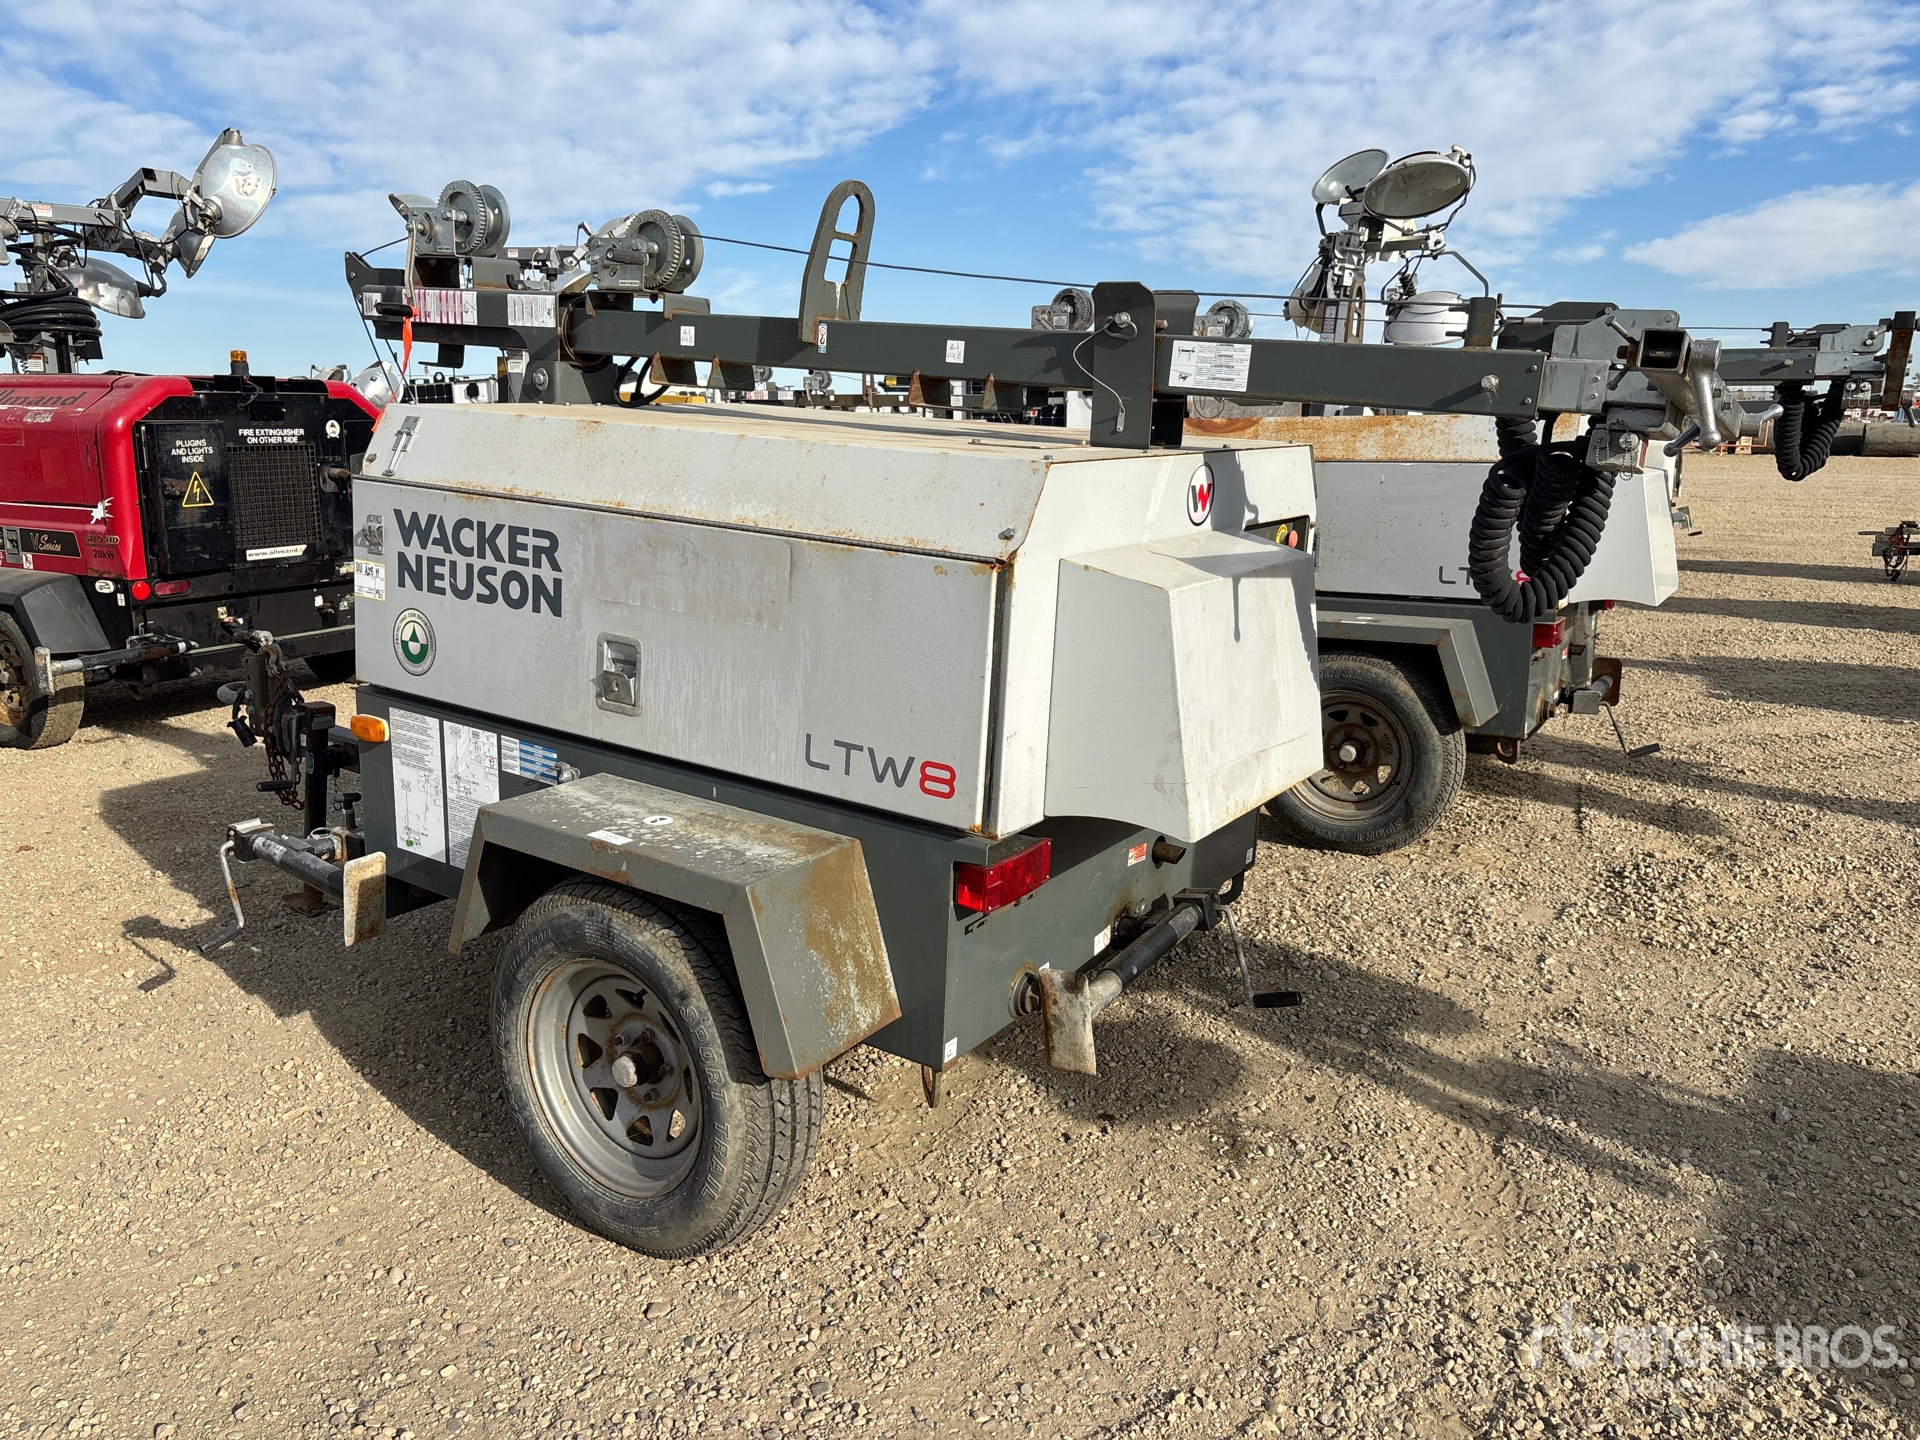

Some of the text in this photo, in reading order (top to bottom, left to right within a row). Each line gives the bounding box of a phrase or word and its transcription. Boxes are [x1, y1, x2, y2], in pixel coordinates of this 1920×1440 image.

[171, 448, 187, 456] AND
[176, 439, 206, 447] PLUGINS
[182, 455, 204, 463] INSIDE
[93, 549, 115, 560] 20kW
[393, 508, 563, 573] WACKER
[397, 550, 563, 618] NEUSON
[805, 733, 957, 799] LTW8
[678, 1004, 731, 1201] SPORT TRAIL
